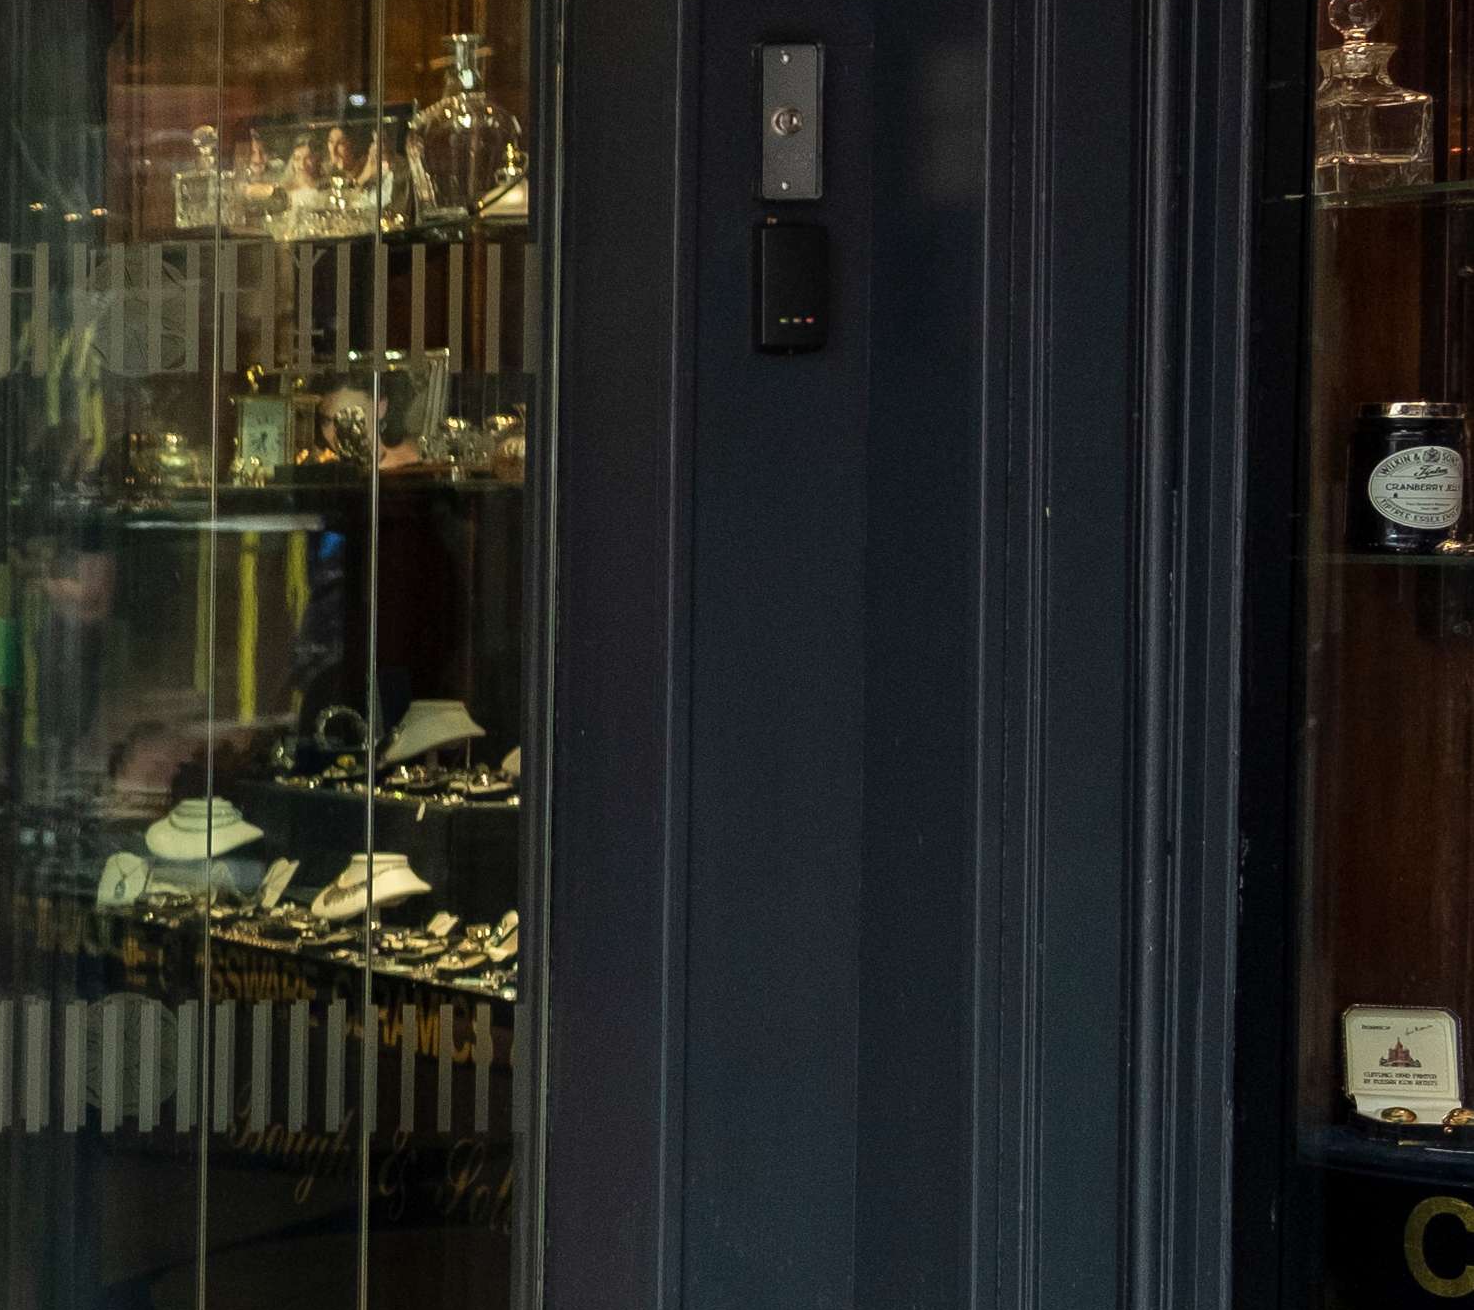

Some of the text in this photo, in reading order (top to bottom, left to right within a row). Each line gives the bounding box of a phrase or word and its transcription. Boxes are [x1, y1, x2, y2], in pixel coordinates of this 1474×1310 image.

[1380, 453, 1411, 475] WILKIN
[1413, 453, 1421, 462] &
[1385, 482, 1443, 492] CRANBERRY
